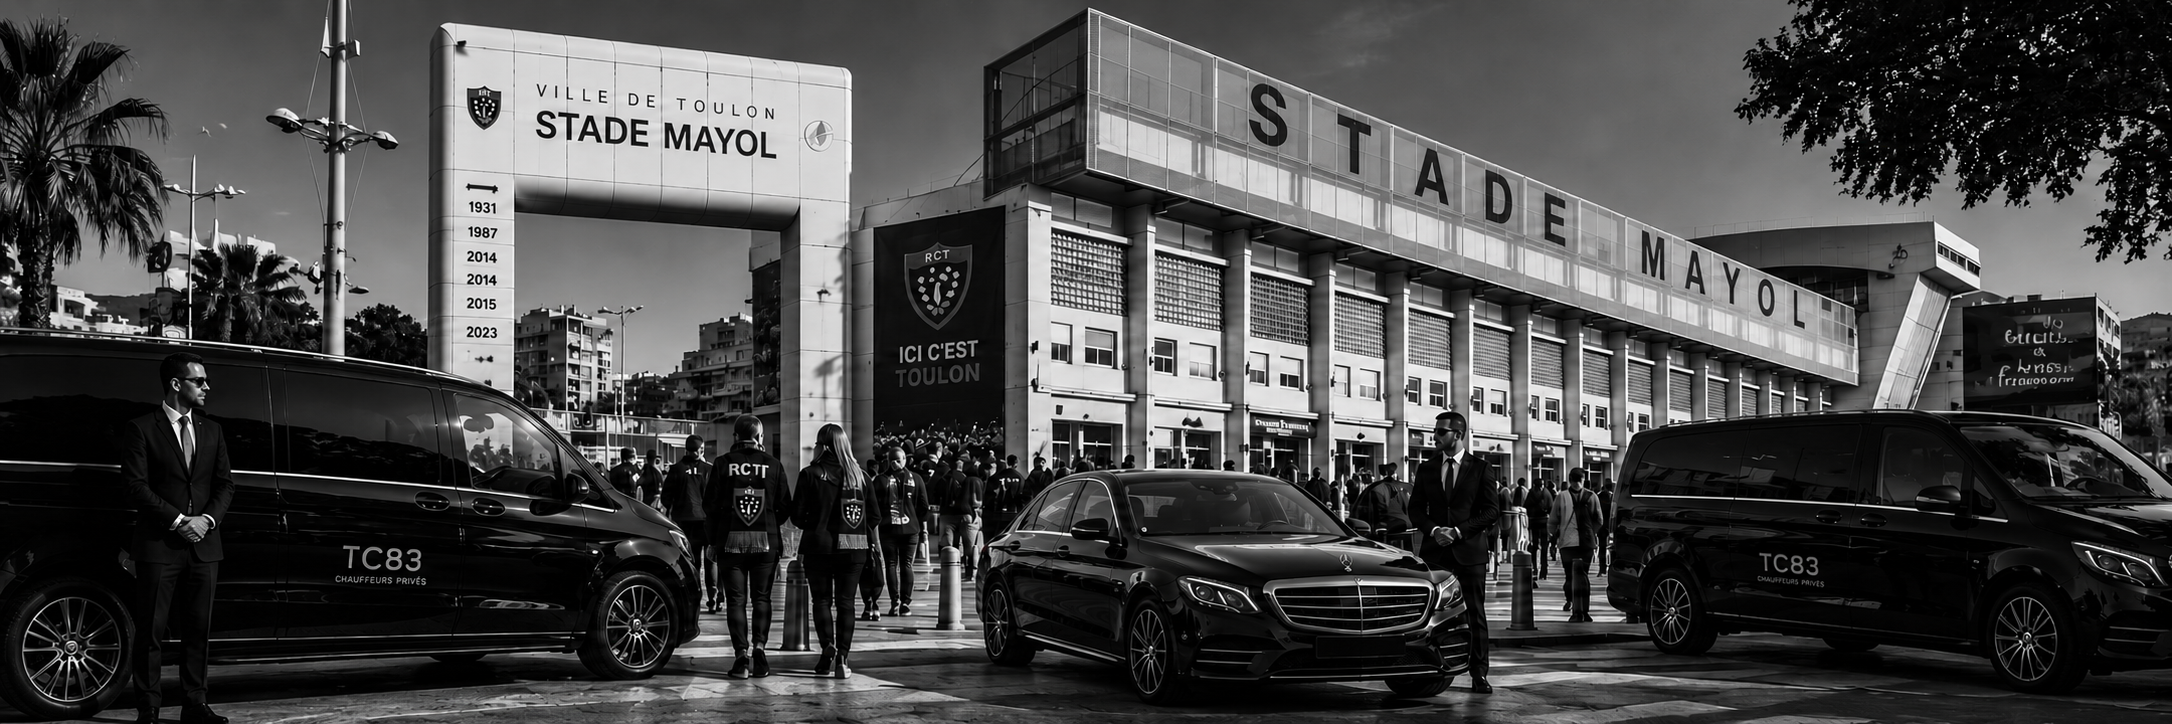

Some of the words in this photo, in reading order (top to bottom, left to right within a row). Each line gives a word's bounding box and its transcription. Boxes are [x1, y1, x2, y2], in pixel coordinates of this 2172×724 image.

[536, 83, 608, 104] VILLE
[628, 92, 656, 109] DE
[676, 97, 775, 120] TOULON
[535, 109, 650, 148] STADE
[663, 121, 777, 160] MAYOL
[468, 201, 497, 214] 1931
[1248, 82, 1567, 247] STADE
[1640, 230, 1806, 330] MAYOL
[467, 226, 498, 239] 1987
[466, 250, 497, 264] 2014
[925, 249, 950, 263] RCT
[466, 273, 497, 287] 2014
[466, 297, 497, 311] 2015
[466, 326, 498, 339] 2023
[899, 345, 922, 364] ICI
[927, 339, 979, 361] C'EST
[895, 362, 980, 388] TOULON
[342, 545, 422, 572] TC83
[1758, 552, 1819, 576] TC83
[335, 575, 393, 584] CHAUFFEURS
[395, 575, 427, 586] PRIVÉS
